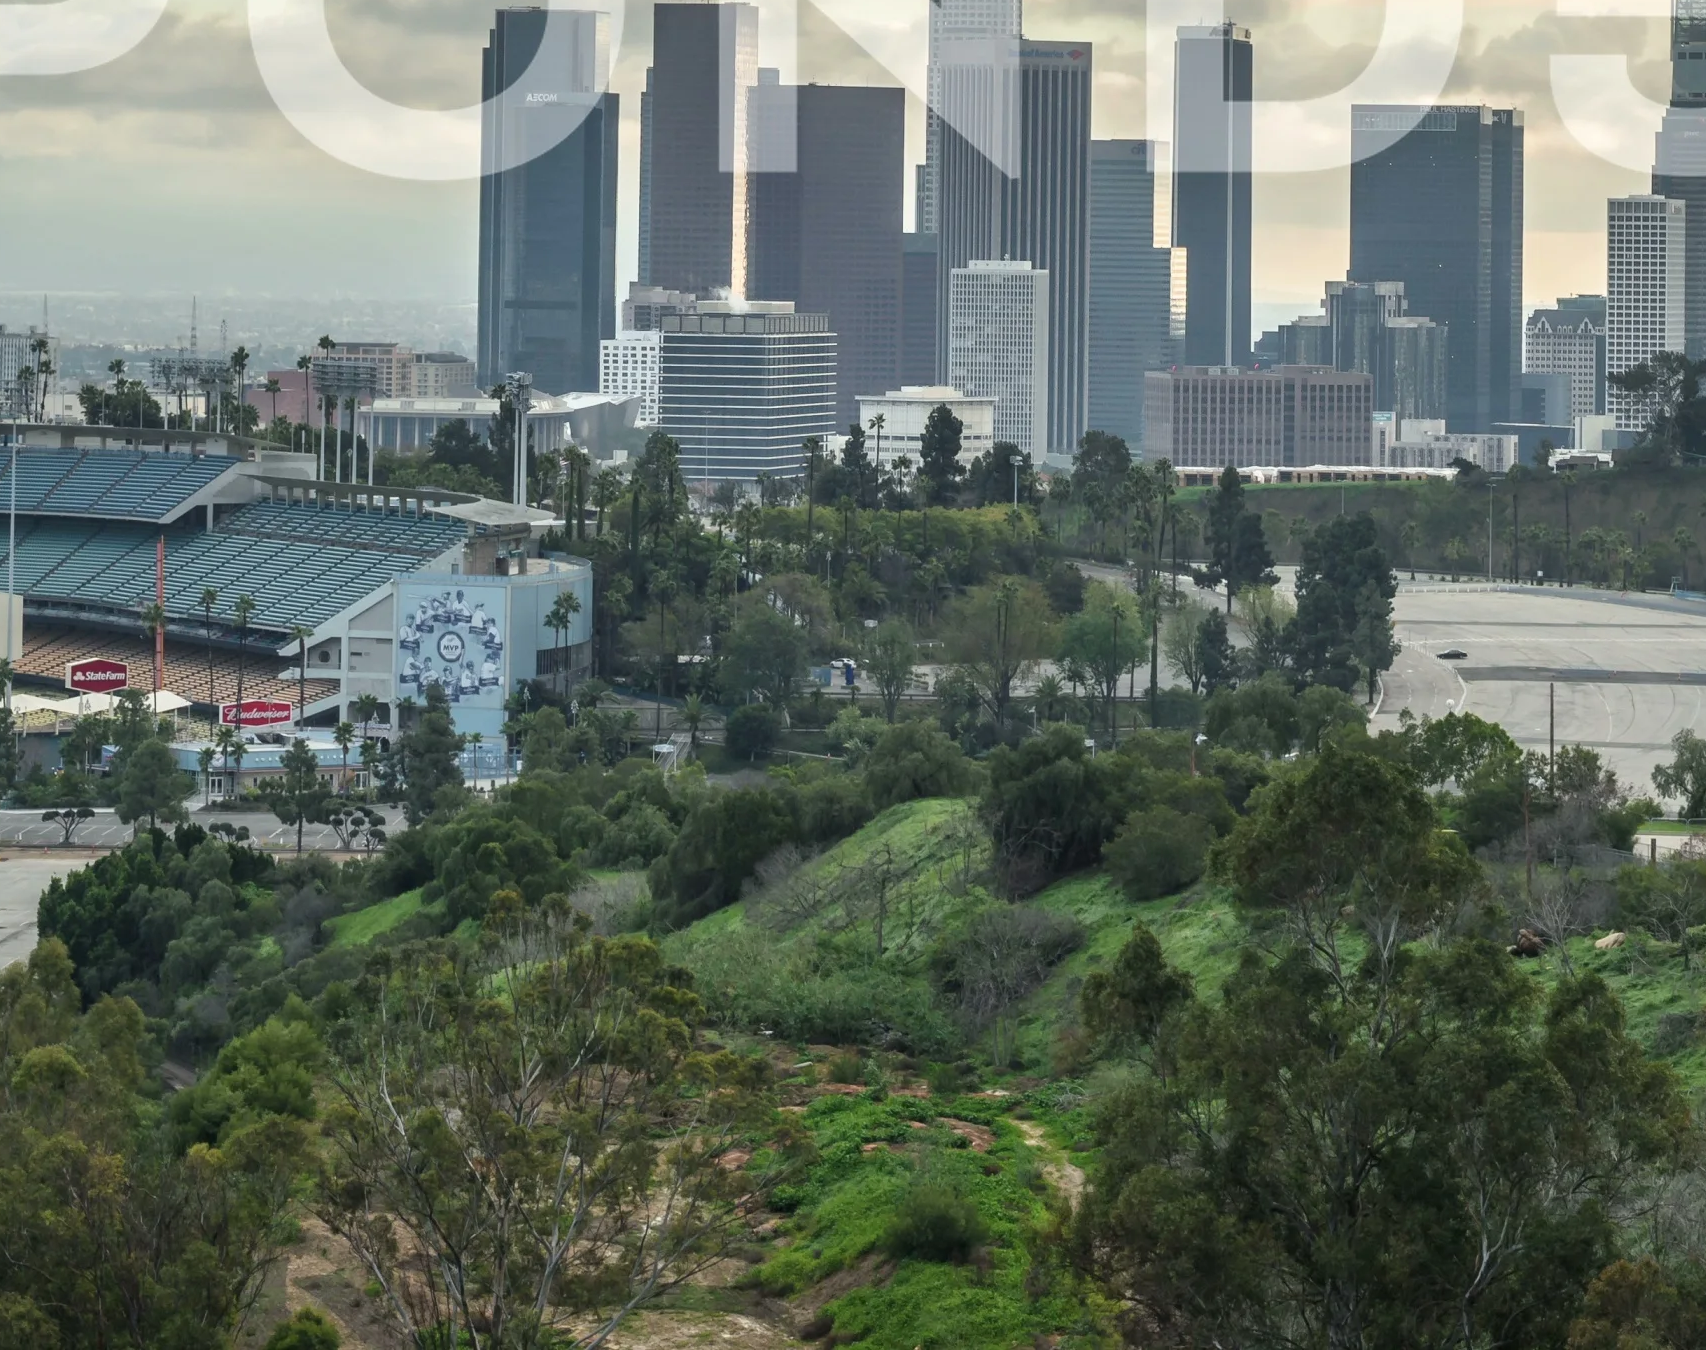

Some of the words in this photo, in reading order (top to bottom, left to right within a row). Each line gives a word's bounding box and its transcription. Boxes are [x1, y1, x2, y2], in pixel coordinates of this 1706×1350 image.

[526, 93, 558, 102] AECOM
[1419, 106, 1439, 114] PAUL
[1441, 106, 1479, 114] HASTINGS
[443, 644, 460, 652] MVP
[224, 707, 290, 721] Budweiser
